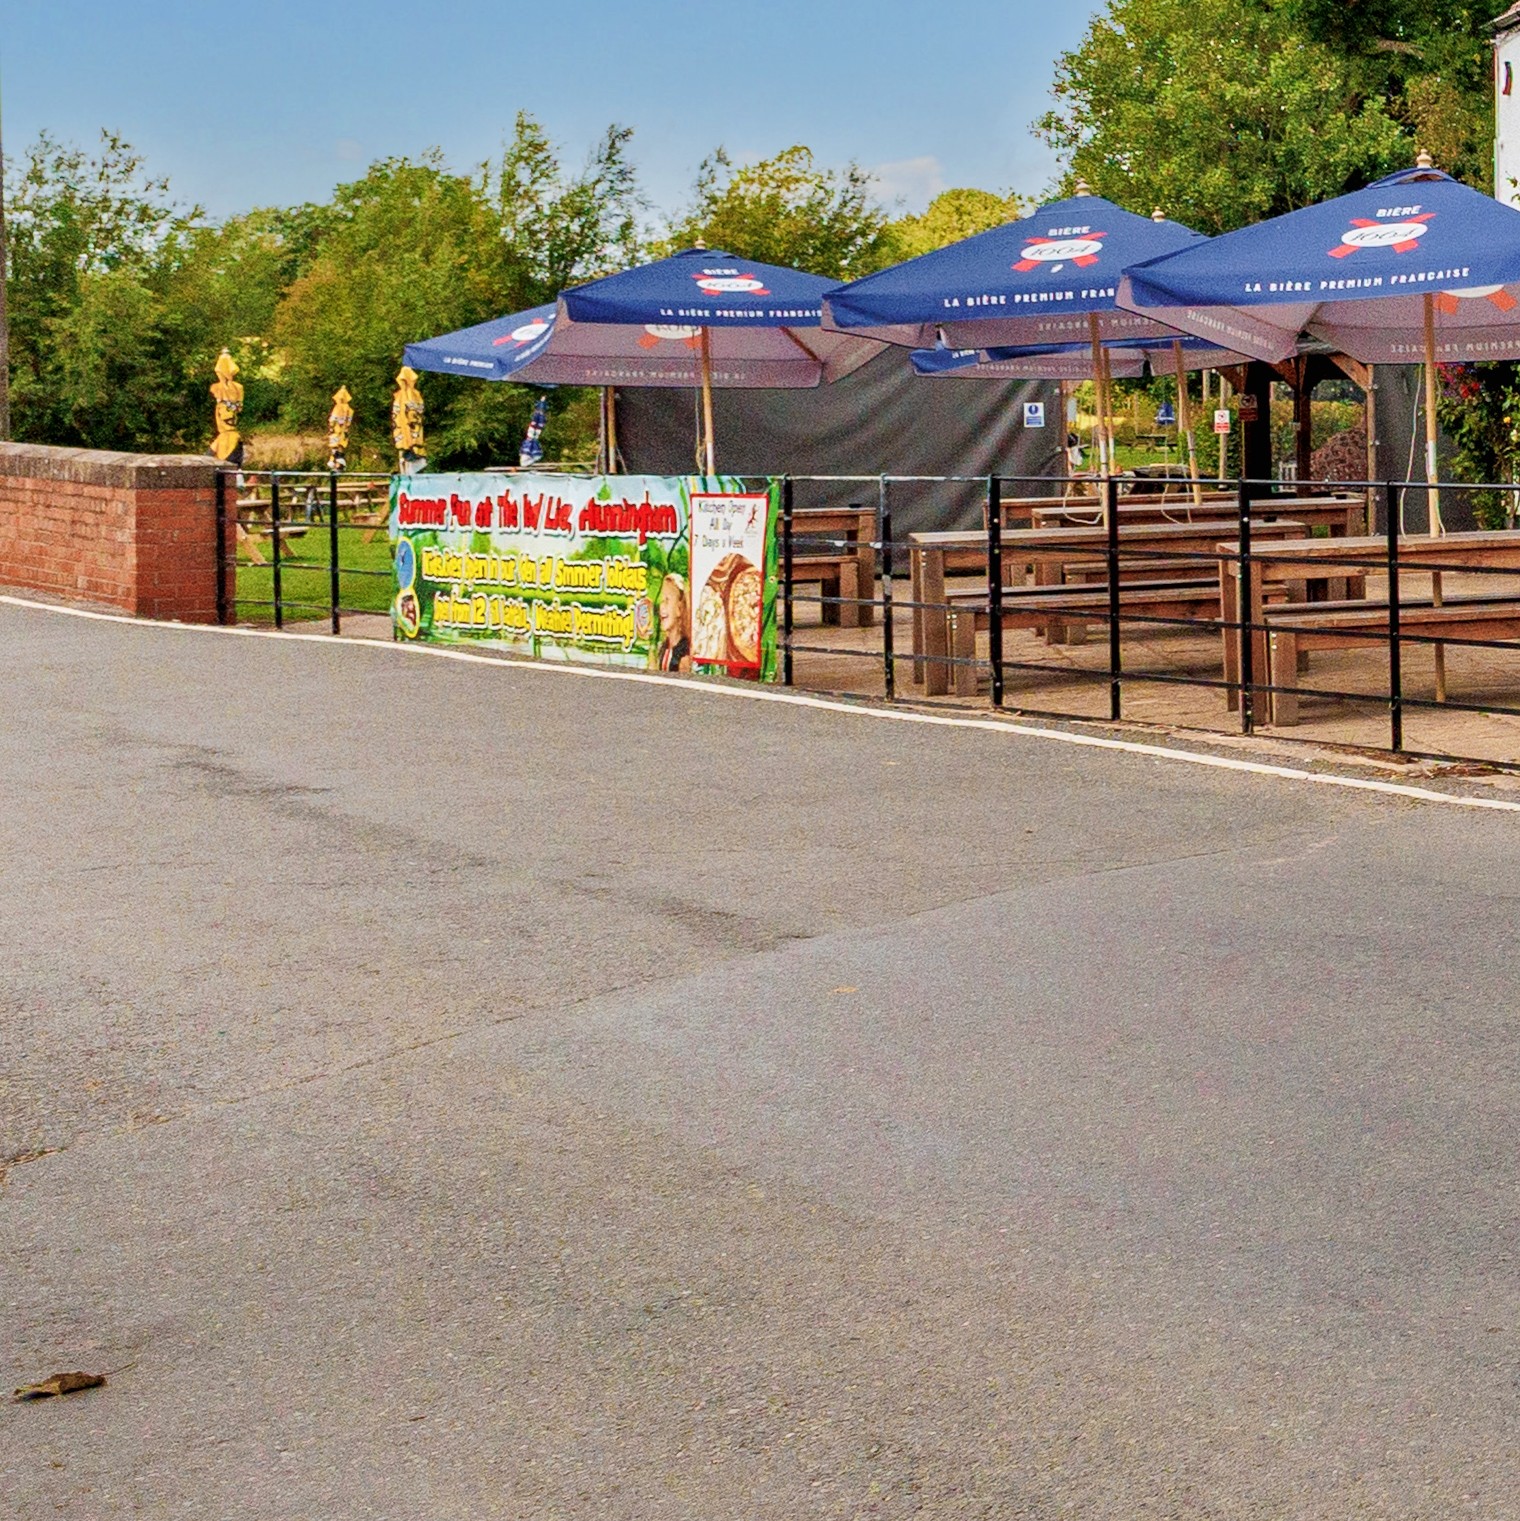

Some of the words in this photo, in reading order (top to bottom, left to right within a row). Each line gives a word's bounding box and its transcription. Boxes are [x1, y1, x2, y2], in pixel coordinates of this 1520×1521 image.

[1244, 281, 1262, 293] LA
[1269, 279, 1312, 293] BIÈRE
[1320, 276, 1383, 291] PREMIUM
[944, 297, 961, 309] LA
[966, 293, 1007, 308] BIÈRE
[1014, 290, 1075, 304] PREMIUM
[659, 308, 674, 317] LA
[715, 309, 765, 319] PREMIUM
[398, 492, 447, 527] Summer
[451, 493, 471, 527] Fun
[475, 496, 493, 529] at
[472, 595, 487, 626] 12
